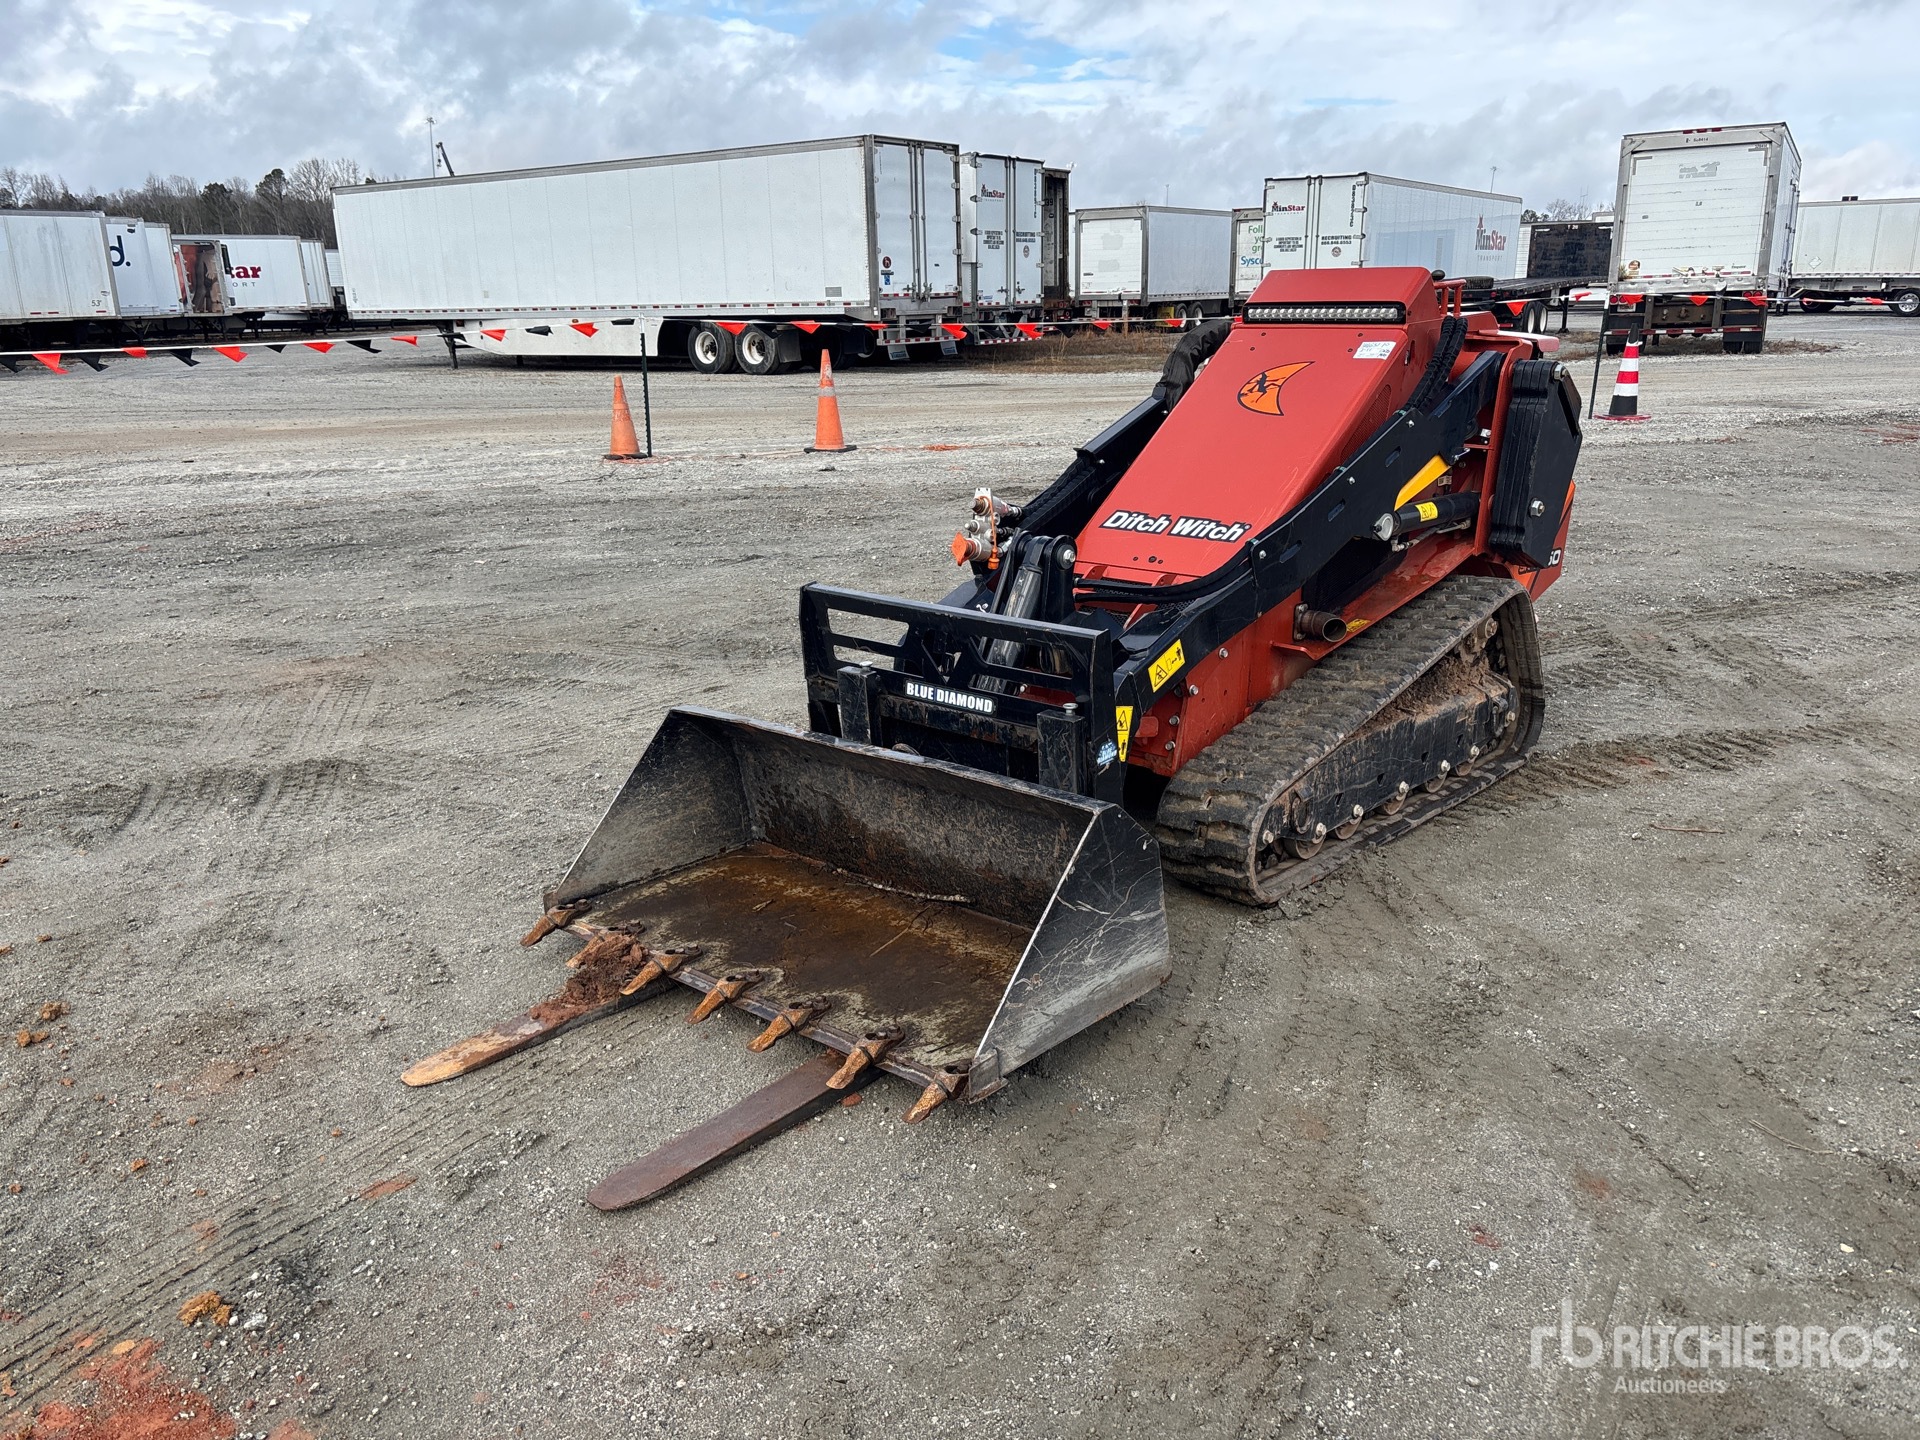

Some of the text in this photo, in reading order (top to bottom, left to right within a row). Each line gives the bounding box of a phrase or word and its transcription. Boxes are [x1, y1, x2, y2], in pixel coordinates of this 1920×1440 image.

[981, 187, 1005, 199] MinStar
[1271, 204, 1305, 212] MinStar
[1248, 224, 1263, 234] Foll
[1475, 228, 1507, 251] MinStar
[1100, 510, 1249, 542] Ditch Witch
[906, 682, 993, 713] BLUE DIAMOND
